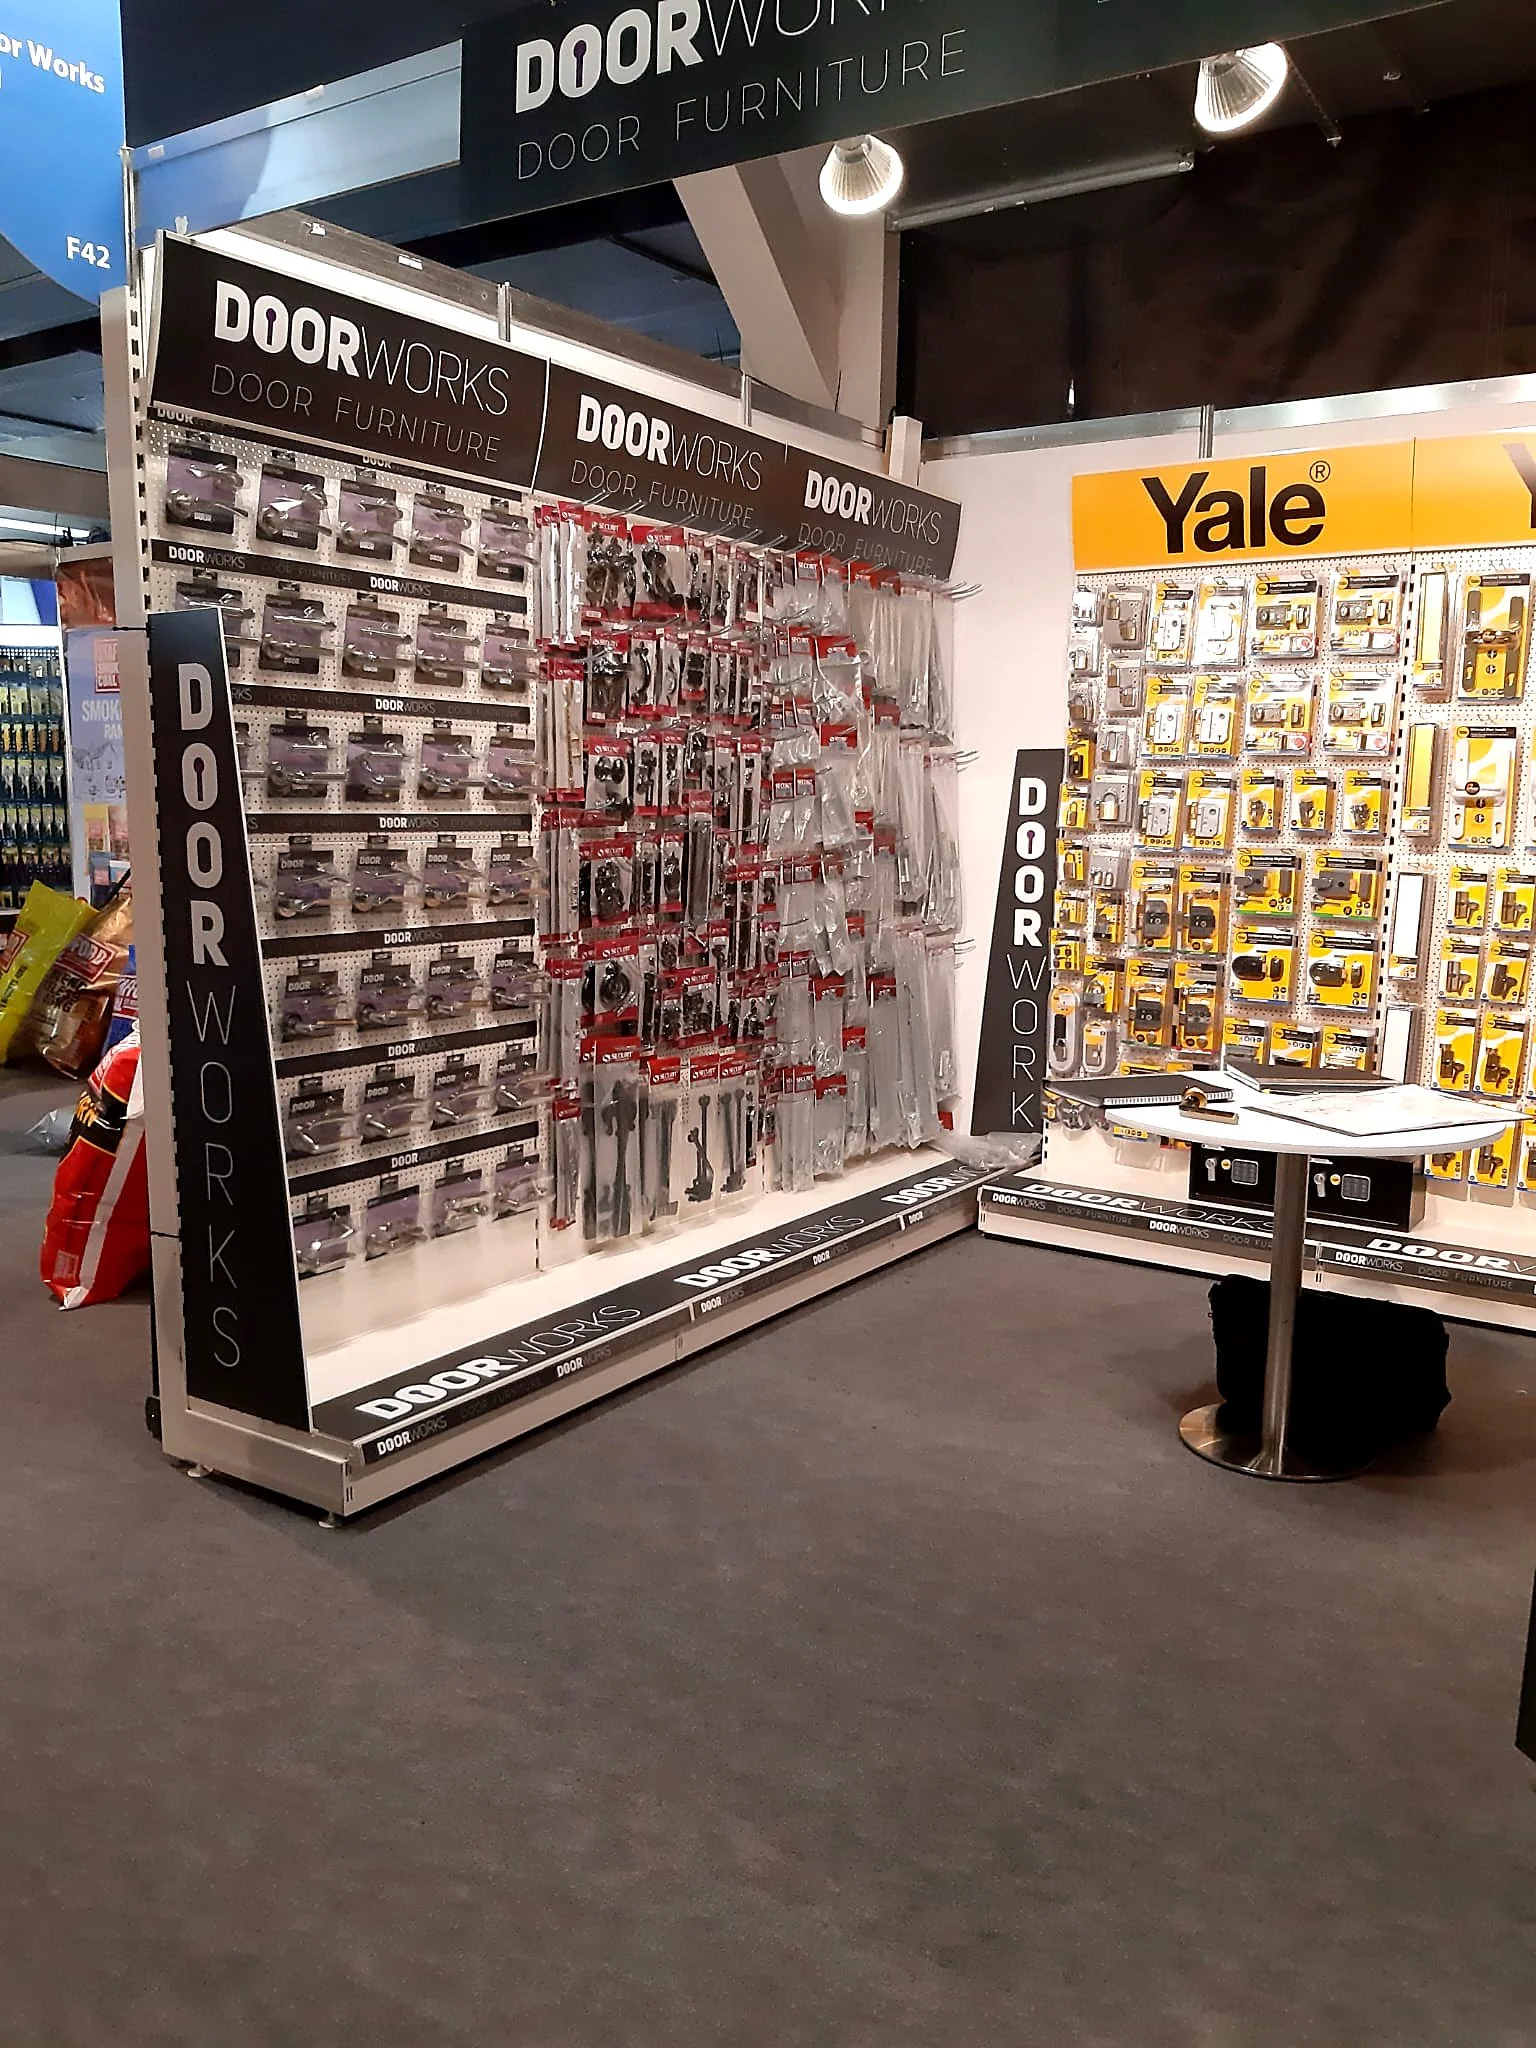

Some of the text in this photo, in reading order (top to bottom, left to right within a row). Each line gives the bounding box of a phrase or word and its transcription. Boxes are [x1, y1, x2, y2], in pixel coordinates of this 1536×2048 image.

[27, 39, 105, 94] Works
[516, 0, 885, 113] DOORWO
[517, 29, 967, 180] DOOR FURNITURE
[66, 235, 111, 269] F42
[213, 280, 510, 416] DOORWORKS
[211, 363, 501, 464] DOOR FURNITURE
[576, 394, 764, 492] DOORWORKS
[570, 459, 754, 529] DOOR FURNITURE
[804, 469, 942, 545] DOORWORKS
[1141, 466, 1326, 554] Yale
[168, 545, 246, 569] DOORWORKS
[798, 522, 934, 575] DOOR FURNITURE
[370, 576, 432, 597] DOORWORKS
[82, 700, 122, 722] SMOK
[1007, 777, 1047, 1128] DOORWORK
[673, 1215, 865, 1289] DOORWORKS
[992, 1192, 1046, 1210] DOORWORKS
[1149, 1219, 1210, 1240] DOORWORKS
[1335, 1251, 1403, 1272] DOORWORKS
[355, 1304, 641, 1420] DOORWORKS
[376, 1415, 448, 1456] DOORWORKS
